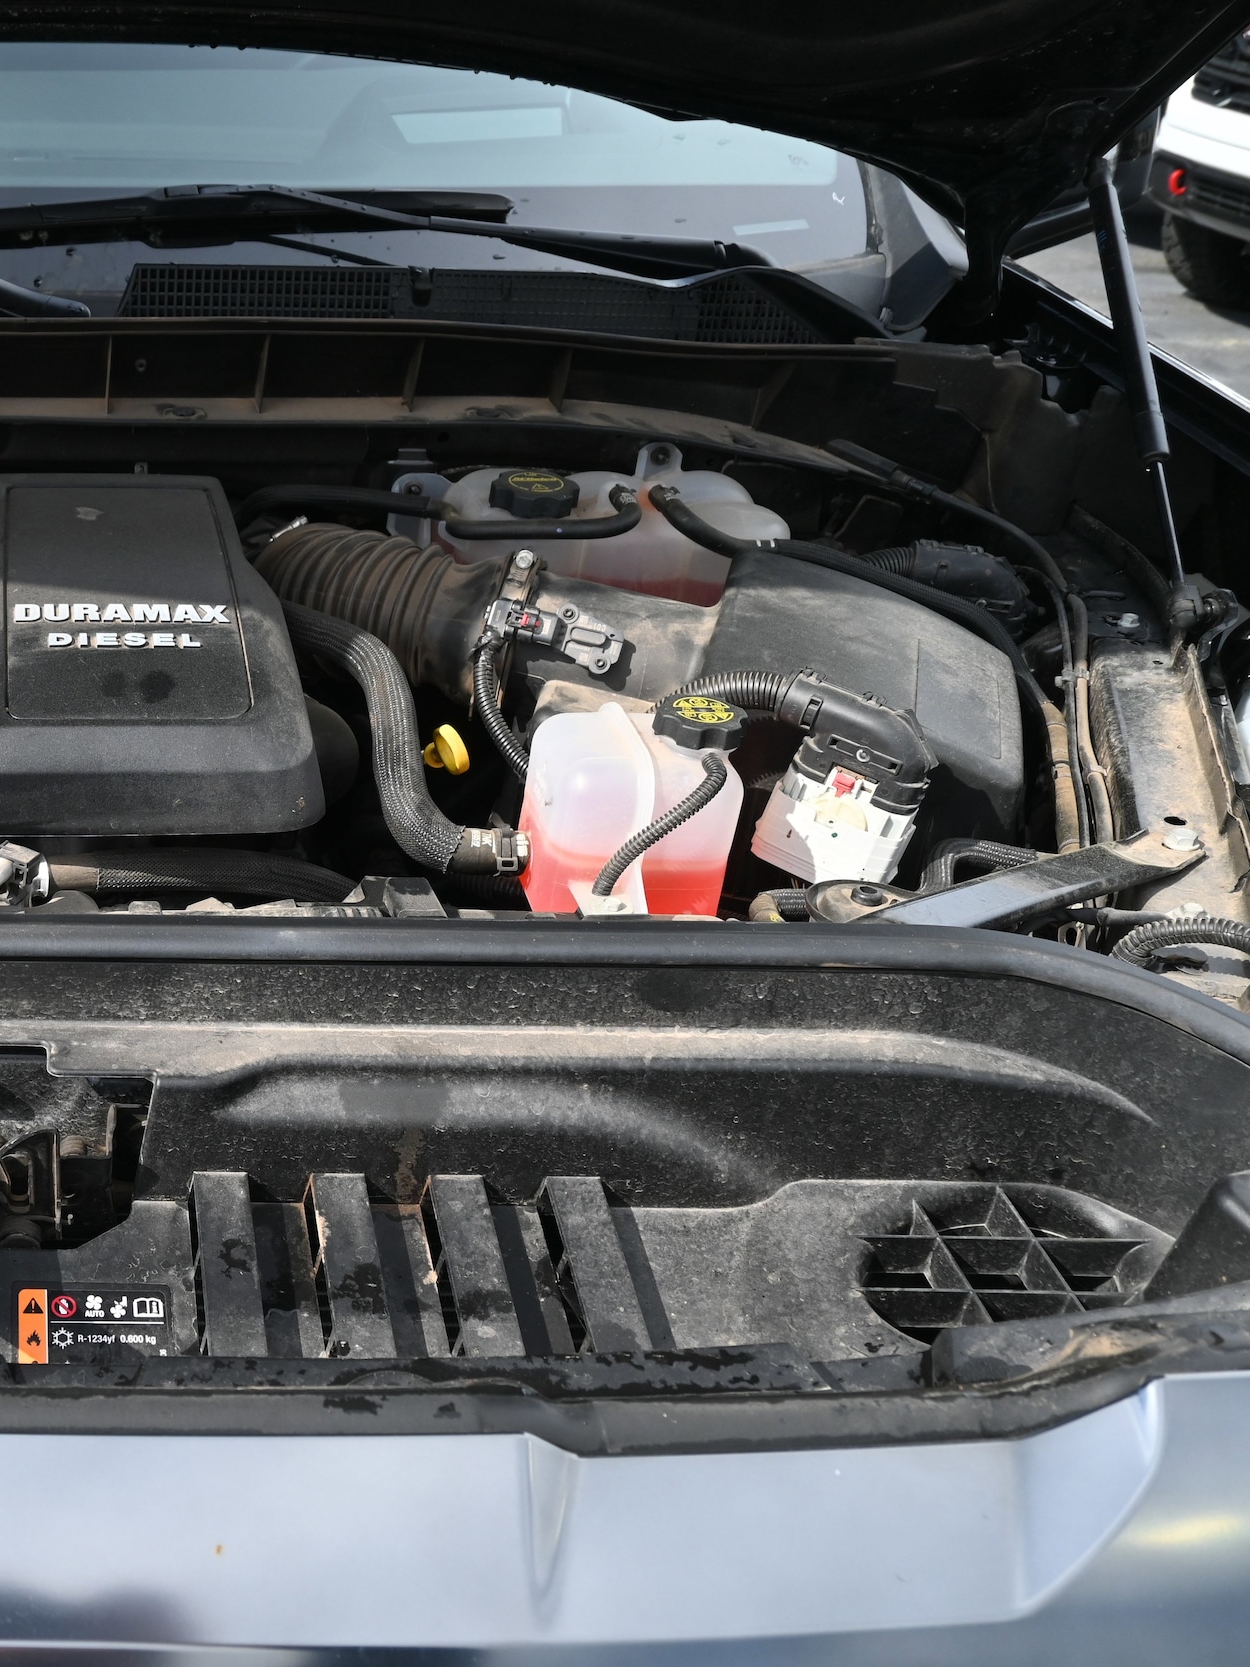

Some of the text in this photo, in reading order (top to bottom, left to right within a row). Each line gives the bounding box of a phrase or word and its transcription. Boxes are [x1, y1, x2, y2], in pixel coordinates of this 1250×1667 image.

[14, 603, 231, 623] DURAMAX
[47, 632, 202, 648] DIESEL
[85, 1310, 105, 1318] AUTO
[77, 1334, 157, 1345] R-1234yf 0.600 kg
